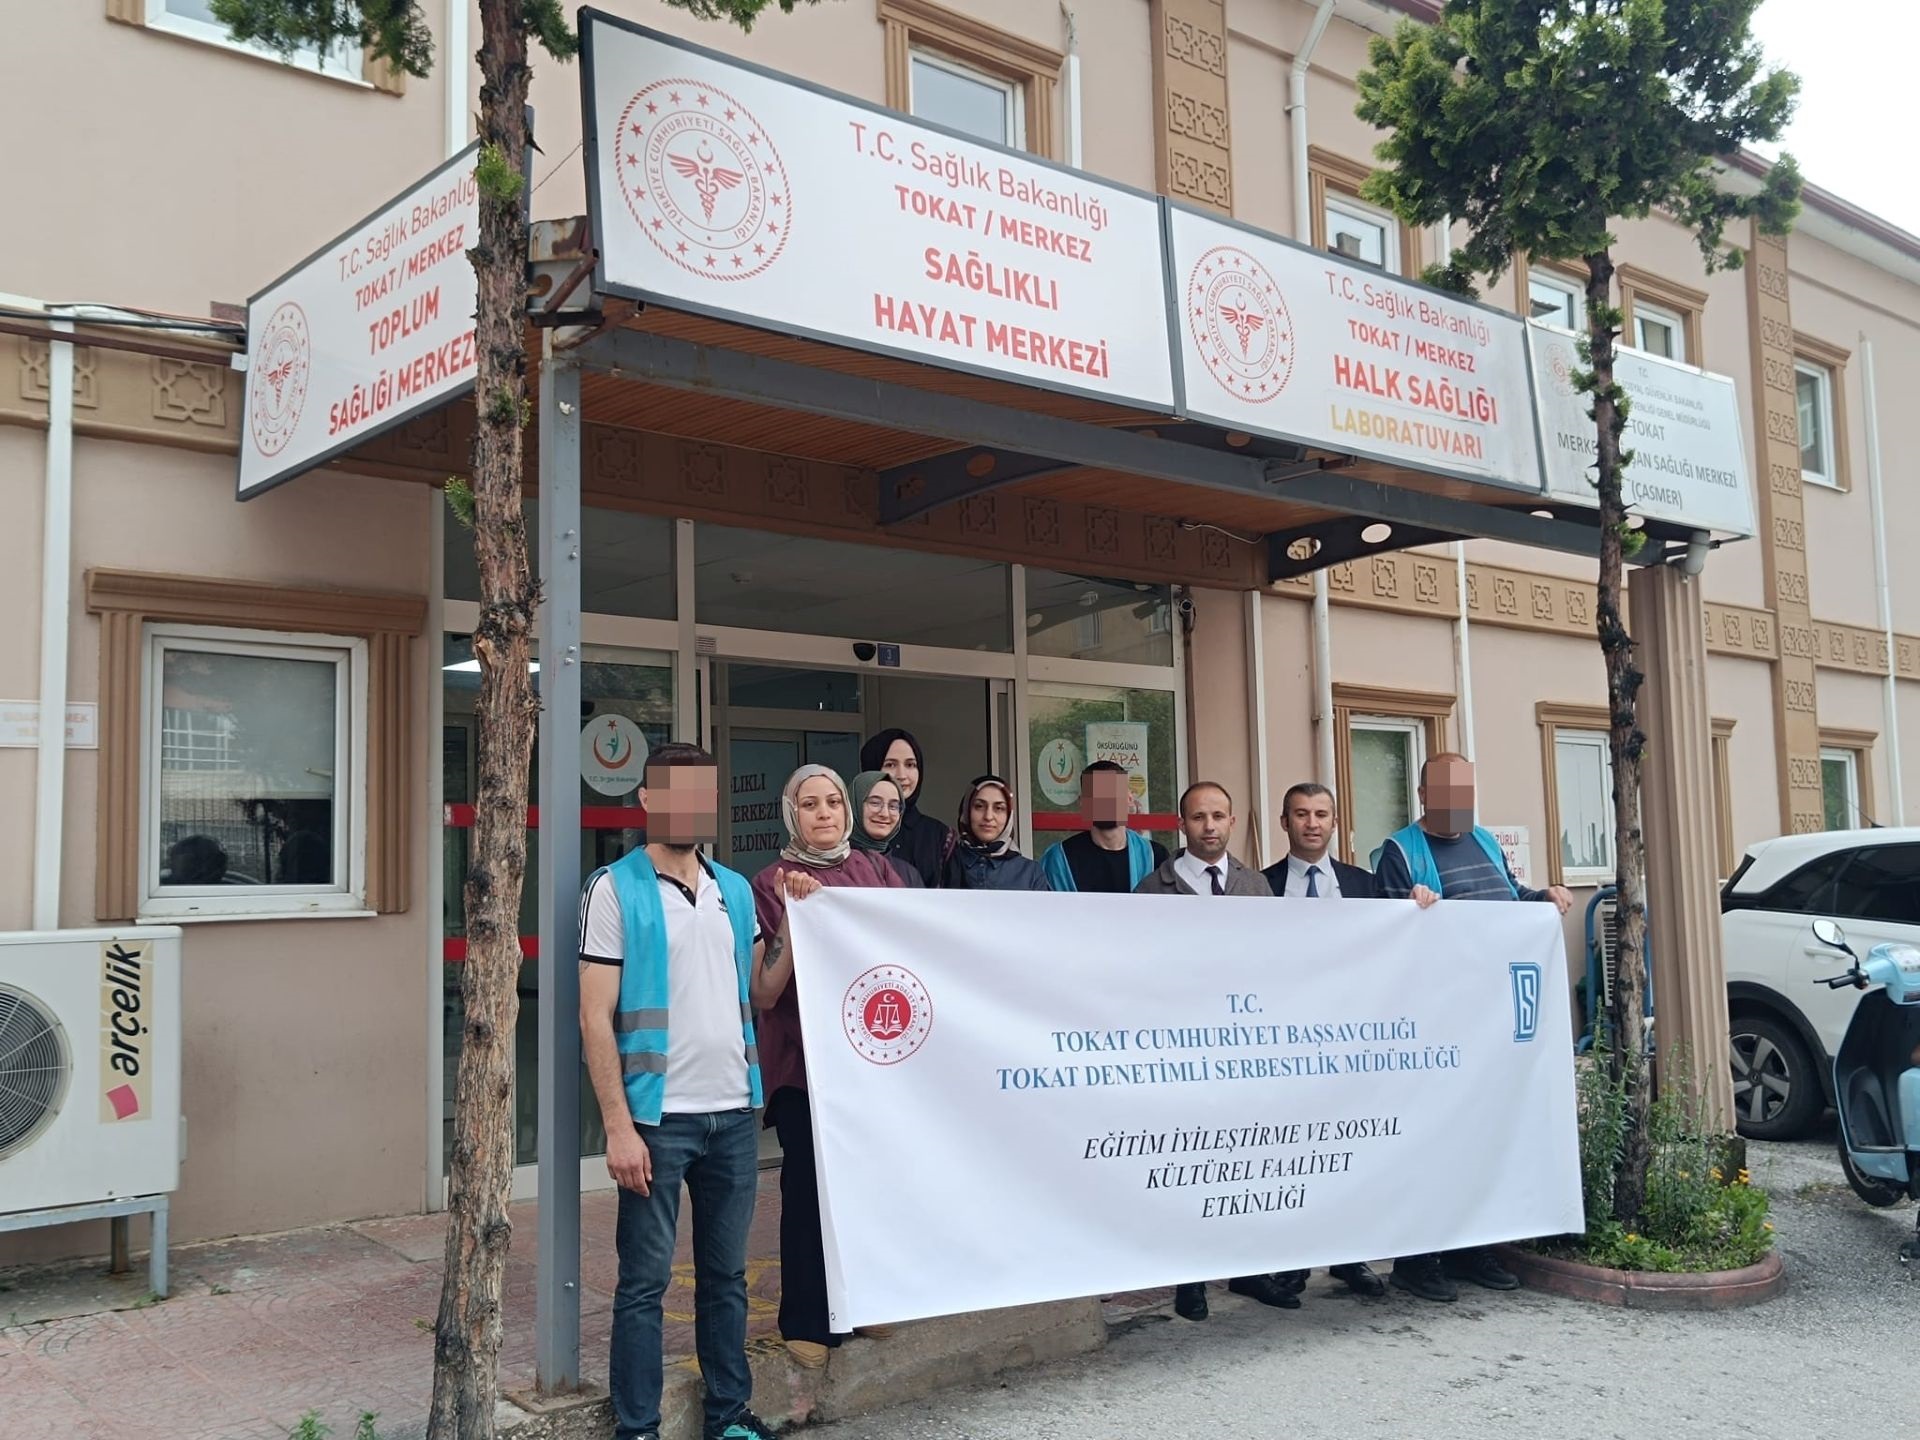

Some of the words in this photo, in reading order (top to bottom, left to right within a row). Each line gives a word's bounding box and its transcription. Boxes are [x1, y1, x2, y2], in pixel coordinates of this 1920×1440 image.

[849, 121, 903, 165] T.C.
[910, 141, 992, 193] Sağlık
[997, 167, 1108, 232] Bakanlığı
[338, 248, 362, 282] T.C.
[366, 217, 408, 265] Sağlık
[411, 169, 478, 235] Bakanlığ
[894, 184, 977, 230] TOKAT
[999, 215, 1092, 262] MERKEZ
[355, 267, 397, 312] TOKAT
[407, 223, 465, 280] MERKEZ
[924, 247, 1058, 311] SAĞLIKLI
[369, 285, 440, 356] TOPLUM
[874, 293, 977, 348] HAYAT
[985, 319, 1109, 379] MERKEZİ
[1325, 270, 1360, 303] T.C.
[1363, 283, 1415, 319] Sağlık
[1418, 301, 1492, 347] Bakanlığı
[1348, 319, 1399, 351] TOKAT
[1415, 339, 1476, 373] MERKEZ
[328, 369, 394, 436] SAĞLIĞI
[1334, 354, 1402, 401] HALK
[1407, 375, 1498, 425] SAĞLIĞI
[1331, 405, 1483, 460] LABORATUVARI
[1631, 418, 1665, 441] TOKAT
[1557, 431, 1599, 456] MERKE
[1654, 454, 1694, 479] SAĞLIĞI
[1696, 464, 1738, 489] MERKEZİ
[1631, 480, 1683, 511] (ÇASMER)
[732, 773, 766, 794] LIKLI
[732, 828, 780, 853] ELDİNİZ
[105, 943, 149, 1077] arçelik
[1226, 993, 1263, 1014] T.C.
[1052, 1029, 1129, 1052] TOKAT
[1134, 1022, 1281, 1050] CUMHURİYET
[1287, 1017, 1417, 1048] BAŞSAVCILIĞI
[996, 1066, 1079, 1090] TOKAT
[1085, 1056, 1209, 1087] DENETİMLİ
[1214, 1051, 1340, 1081] SERBESTLİK
[1344, 1045, 1462, 1073] MÜDÜRLÜĞÜ
[1083, 1130, 1168, 1160] EĞİTİM
[1170, 1121, 1302, 1153] İYİLEŞTİRME
[1305, 1121, 1331, 1142] VE
[1334, 1116, 1402, 1140] SOSYAL
[1145, 1158, 1255, 1190] KÜLTÜREL
[1259, 1150, 1354, 1179] FAALİYET
[1201, 1183, 1306, 1219] ETKİNLİĞİ
